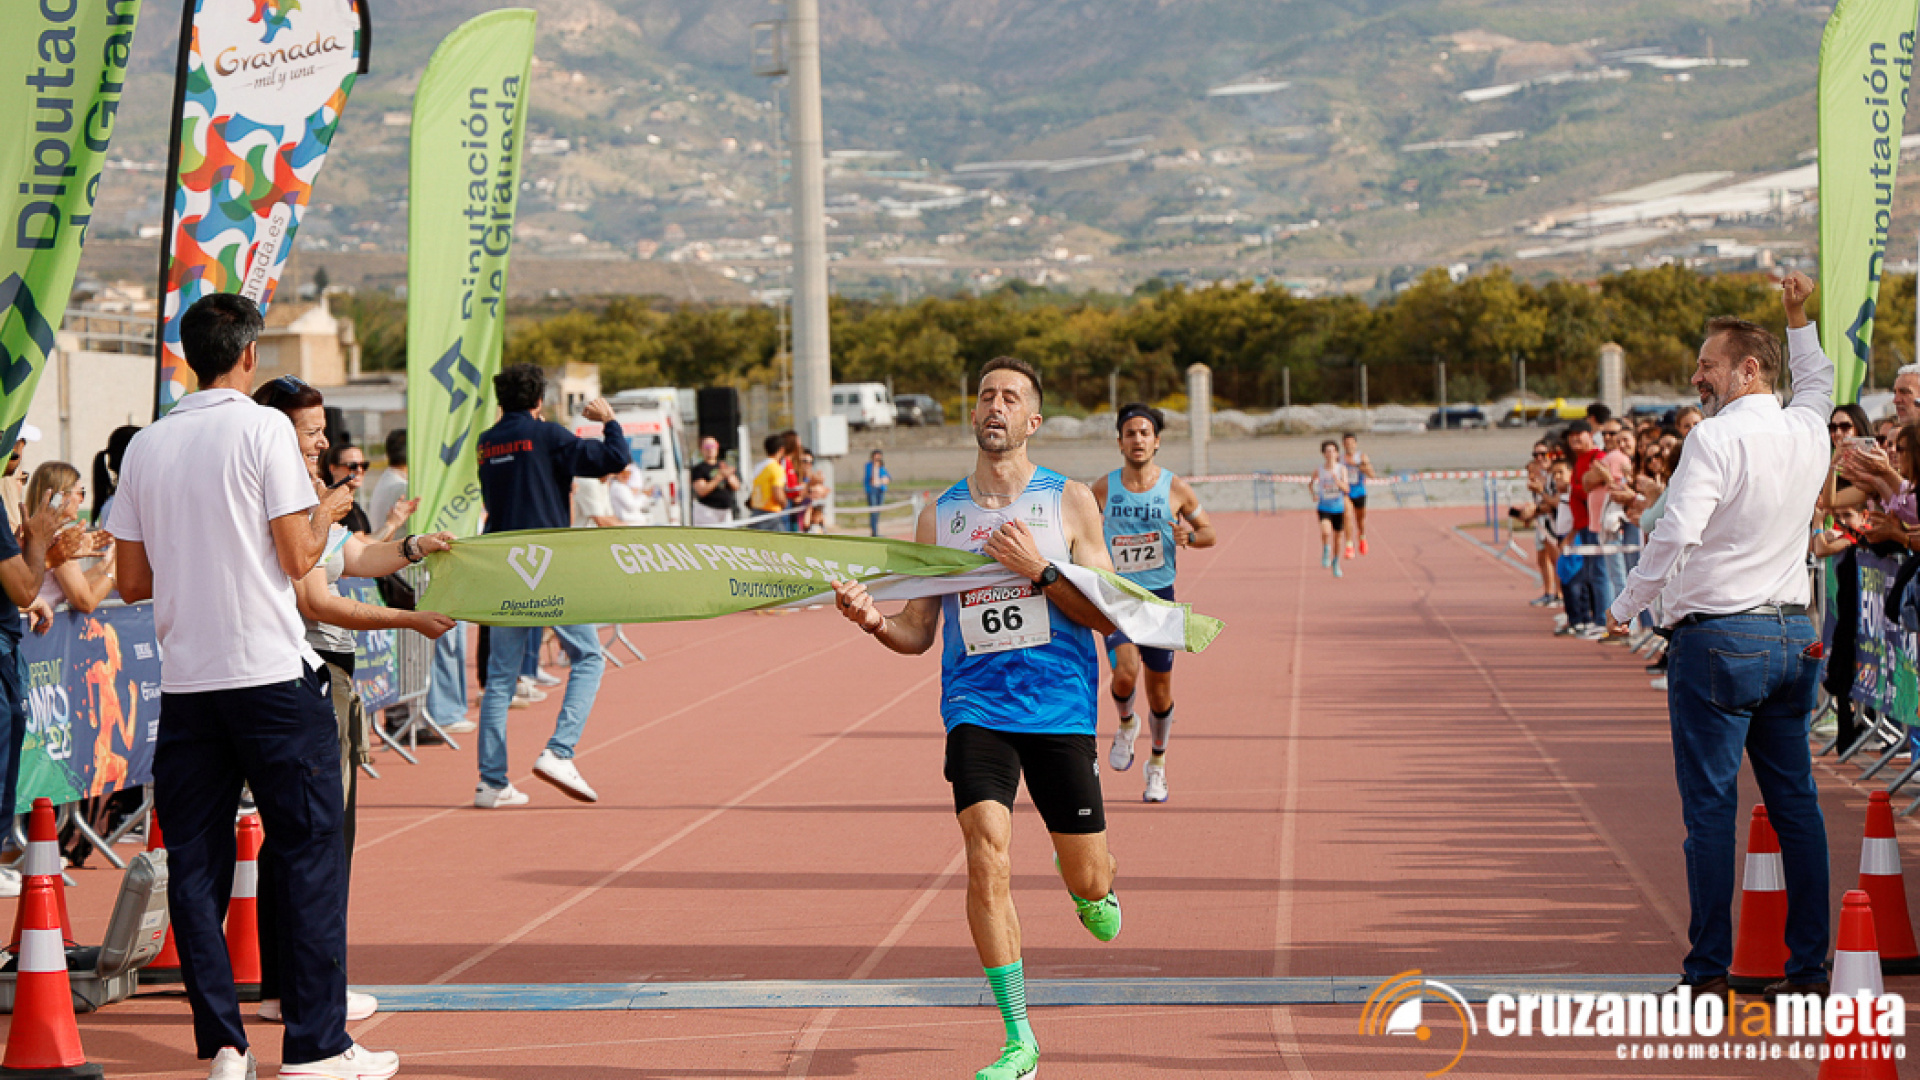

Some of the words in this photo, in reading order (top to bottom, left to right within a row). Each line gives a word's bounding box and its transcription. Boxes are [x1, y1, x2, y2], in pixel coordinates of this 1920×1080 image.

[214, 30, 346, 77] Granada
[253, 67, 277, 89] mil
[277, 72, 287, 91] y
[290, 65, 315, 80] una
[1111, 503, 1162, 522] nerja
[610, 543, 703, 574] GRAN
[1119, 545, 1156, 563] 172
[981, 605, 1023, 634] 66
